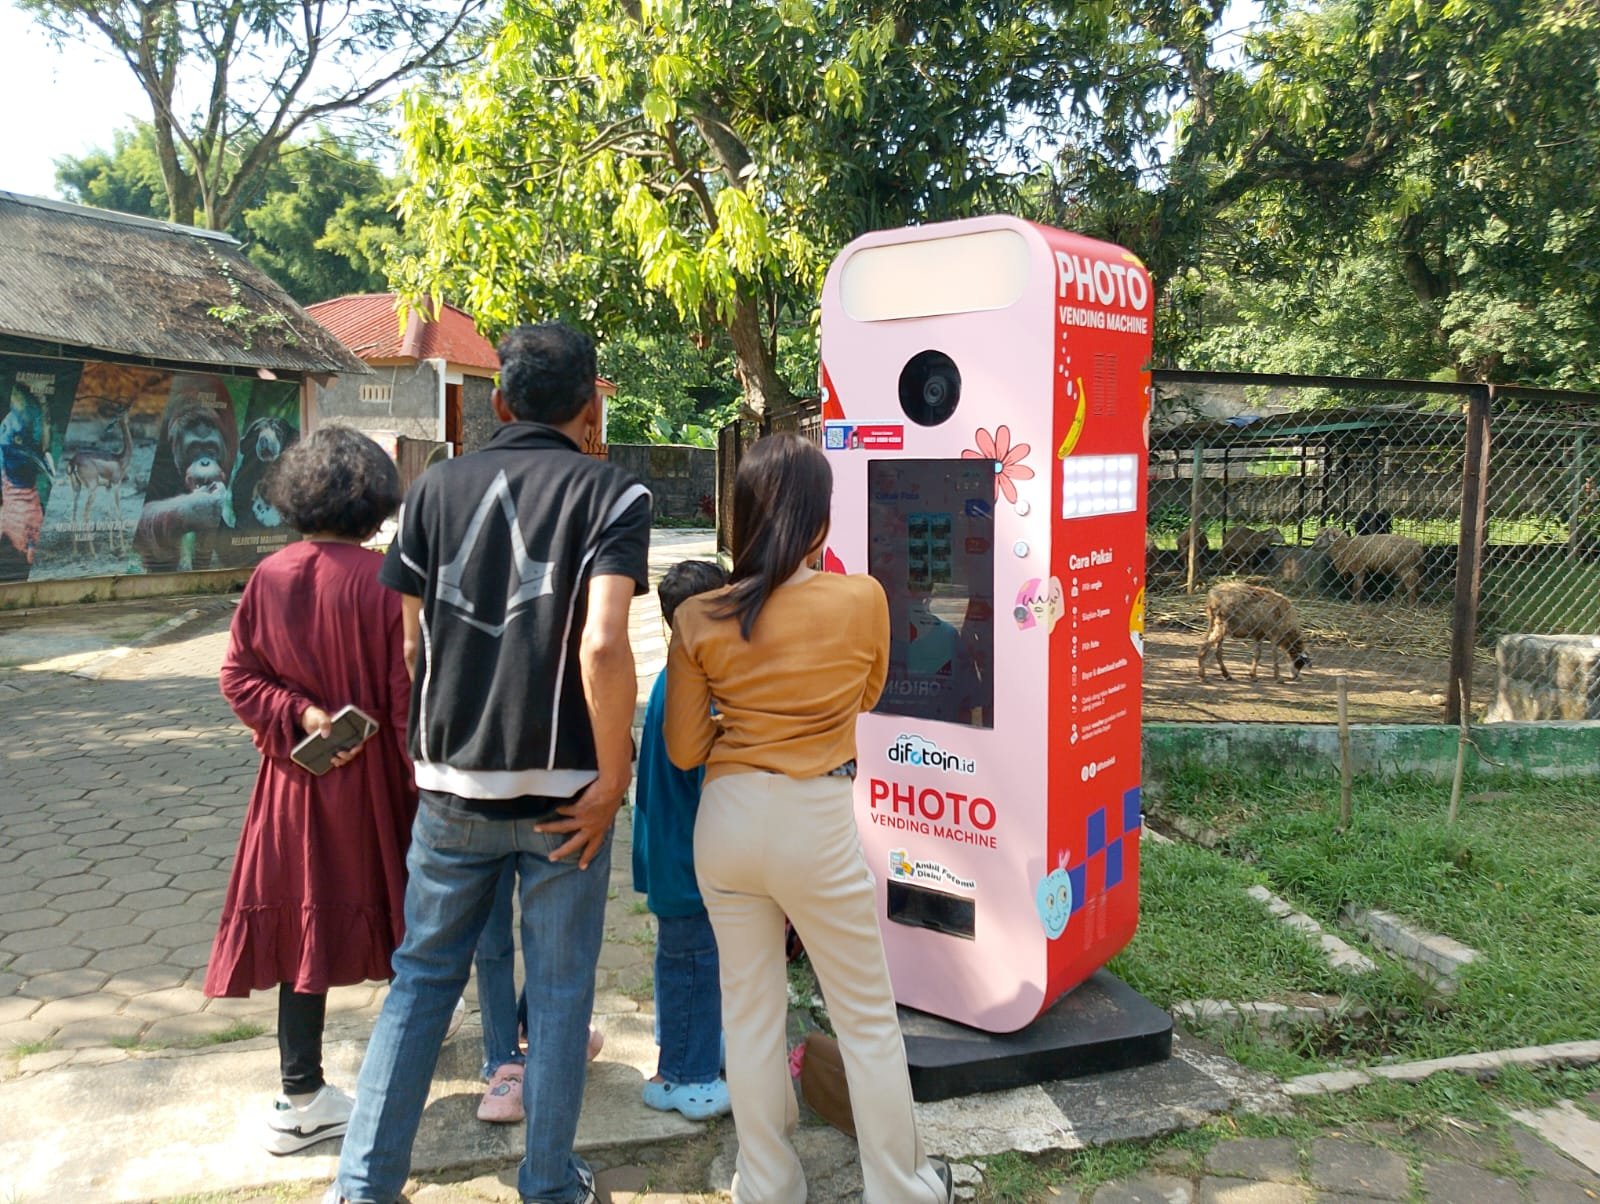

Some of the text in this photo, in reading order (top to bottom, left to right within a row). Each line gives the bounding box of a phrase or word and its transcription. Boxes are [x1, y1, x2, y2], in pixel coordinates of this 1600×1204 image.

[1054, 250, 1148, 311] PHOTO
[1059, 305, 1148, 335] VENDING MACHINE
[1069, 547, 1113, 571] Cara Pakai
[870, 778, 997, 831] PHOTO
[870, 812, 998, 849] VENDING MACHINE
